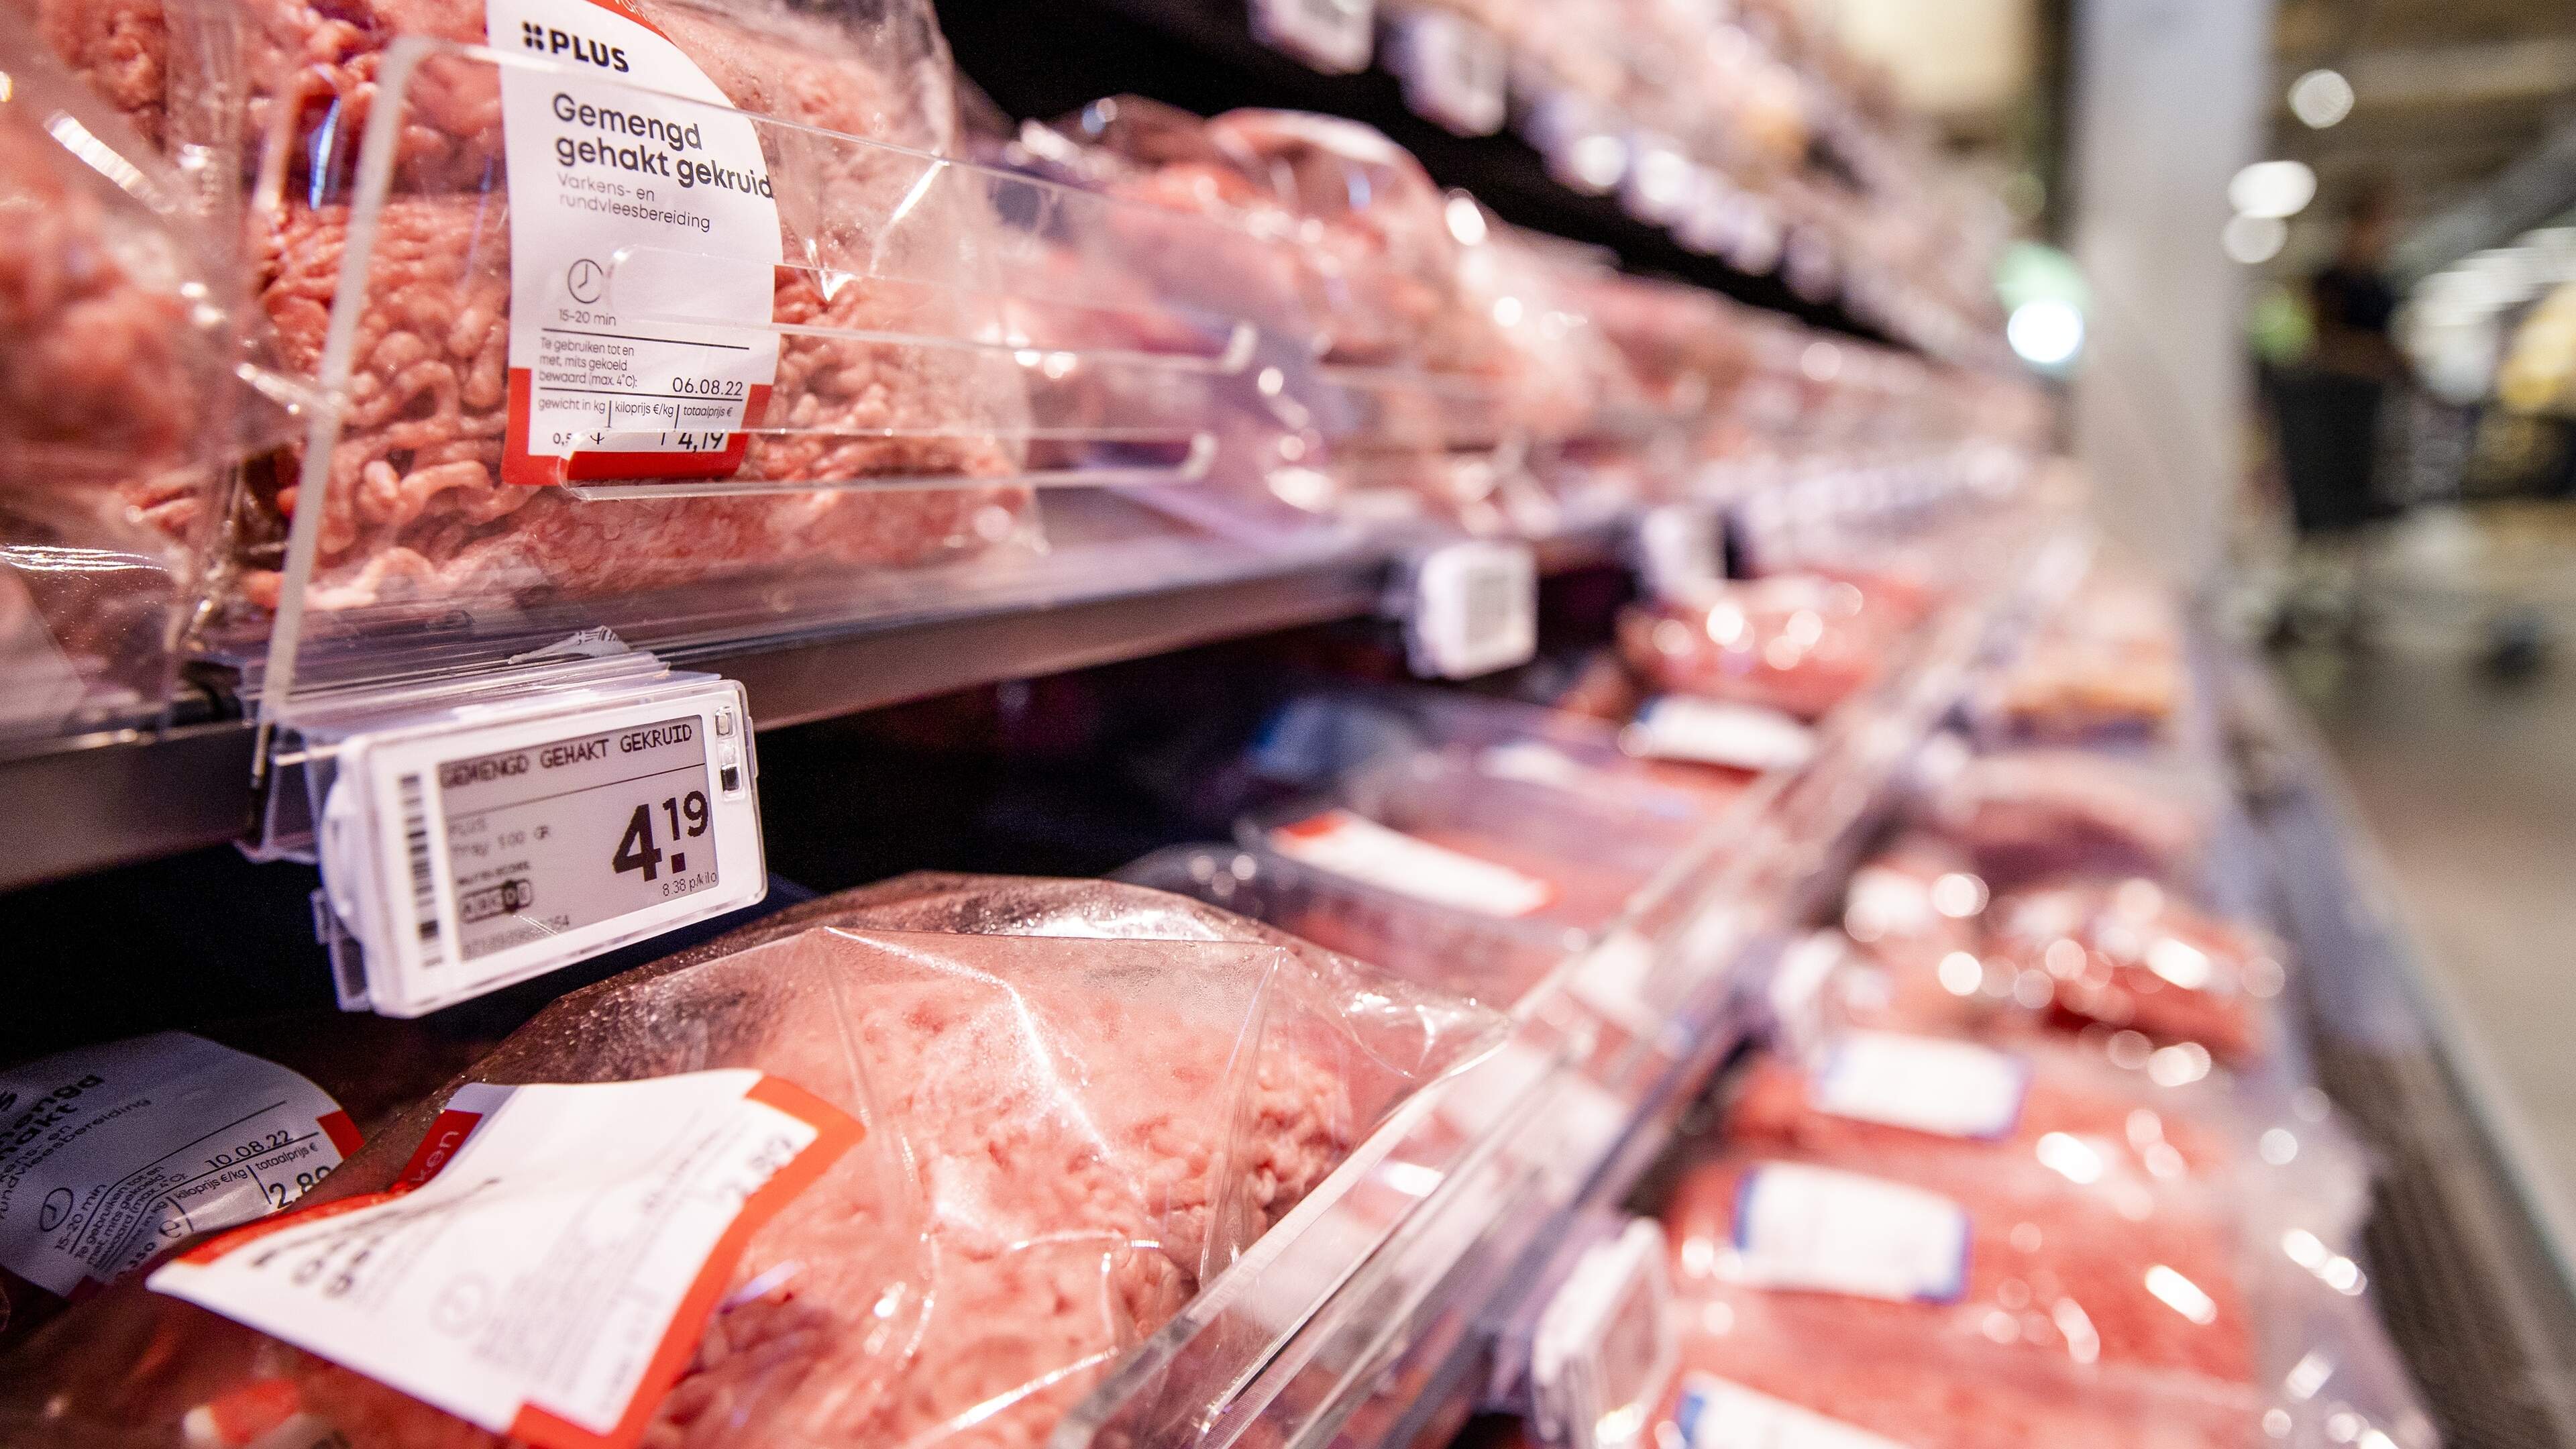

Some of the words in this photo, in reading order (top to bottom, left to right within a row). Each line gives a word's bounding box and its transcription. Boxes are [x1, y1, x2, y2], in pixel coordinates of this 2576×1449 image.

[549, 28, 629, 72] PLUS
[553, 93, 702, 152] Gemengd
[555, 137, 669, 176] gehakt
[677, 158, 774, 200] gekruid
[557, 172, 631, 197] Varkens-
[637, 185, 655, 202] en
[560, 193, 710, 233] rundvleesbereiding
[559, 309, 590, 324] 15-20
[594, 313, 616, 326] min
[541, 337, 551, 349] Te
[554, 339, 605, 354] gebruiken
[608, 344, 621, 355] tot
[623, 346, 634, 356] en
[539, 355, 561, 367] met,
[565, 356, 586, 368] mits
[589, 358, 627, 371] gekoeld
[539, 371, 586, 384] bewaard
[589, 372, 614, 386] (max.
[673, 377, 743, 396] 06.08.22
[538, 398, 580, 411] gewicht
[582, 399, 590, 410] in
[593, 400, 605, 414] kg
[614, 401, 651, 416] kiloprijs
[653, 403, 674, 417] €/kg
[684, 406, 724, 419] totaalprijs
[540, 739, 610, 769] GEHAKT
[620, 724, 692, 753] GEKRUID
[662, 877, 686, 897] 8.38
[689, 871, 717, 892] p/kilo
[48, 1124, 72, 1141] en
[205, 1130, 294, 1169] 10.08.22
[255, 1146, 309, 1171] totaalprijs
[81, 1183, 107, 1211] min
[173, 1178, 221, 1200] kiloprijs
[220, 1168, 248, 1183] €/kg
[74, 1246, 89, 1258] Te
[86, 1186, 127, 1244] gebruiken
[127, 1175, 147, 1186] tot
[146, 1165, 164, 1175] en
[104, 1211, 123, 1236] mits
[119, 1173, 166, 1210] gekoeld
